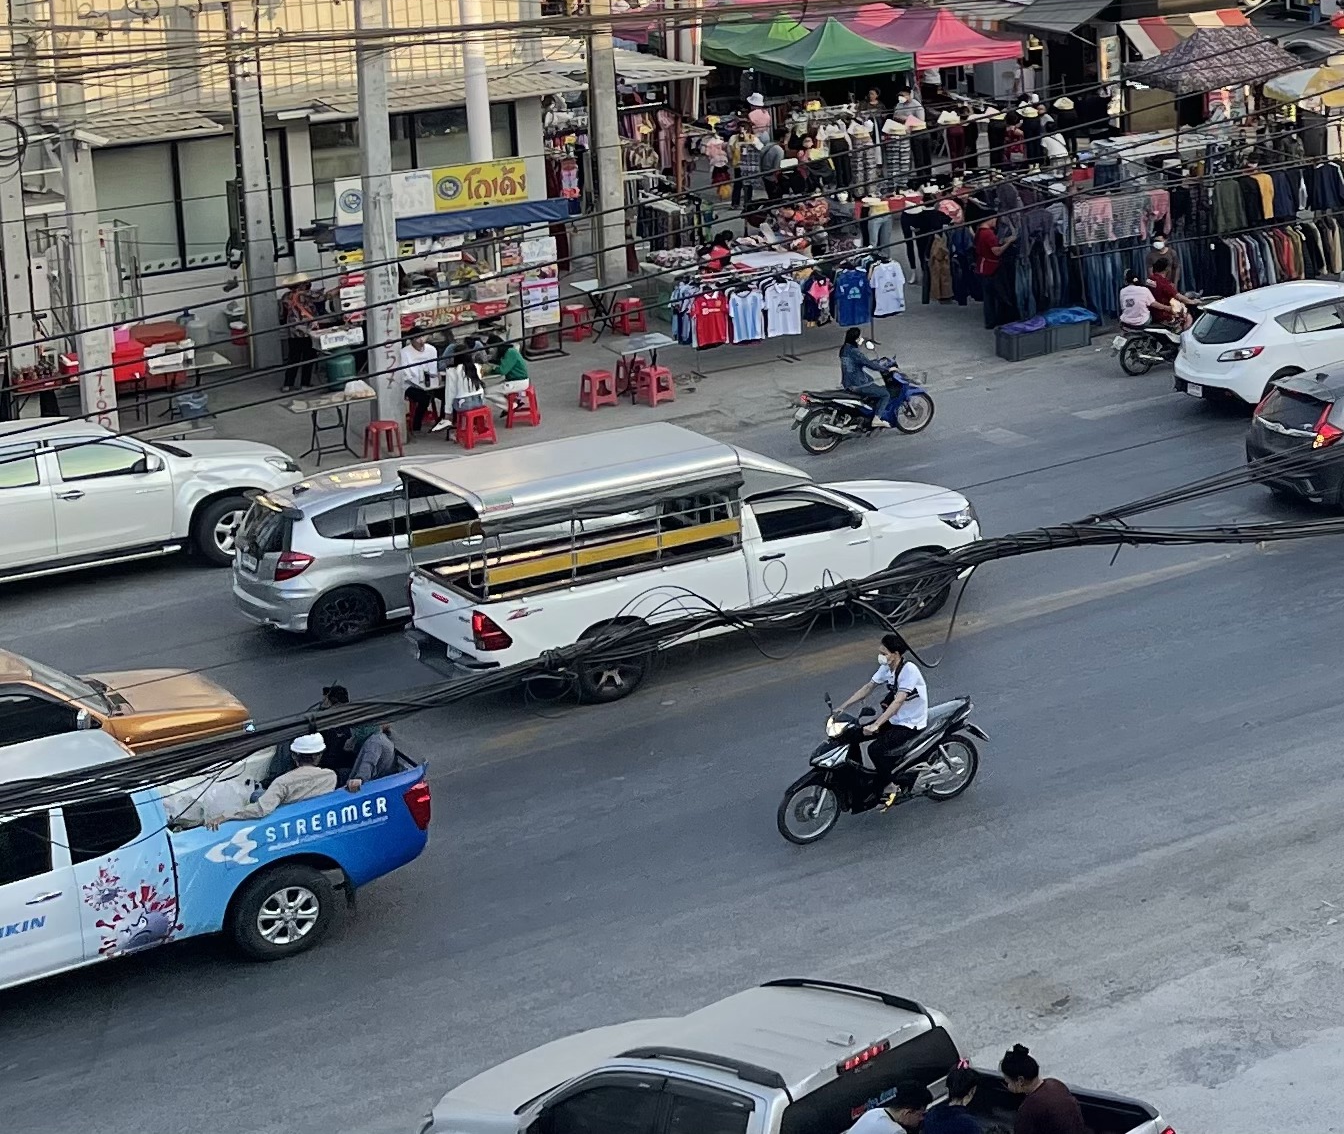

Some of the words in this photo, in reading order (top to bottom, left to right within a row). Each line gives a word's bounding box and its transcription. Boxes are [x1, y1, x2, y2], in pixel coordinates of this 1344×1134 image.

[462, 165, 527, 201] โกเด้ง
[265, 796, 388, 843] STREAMER
